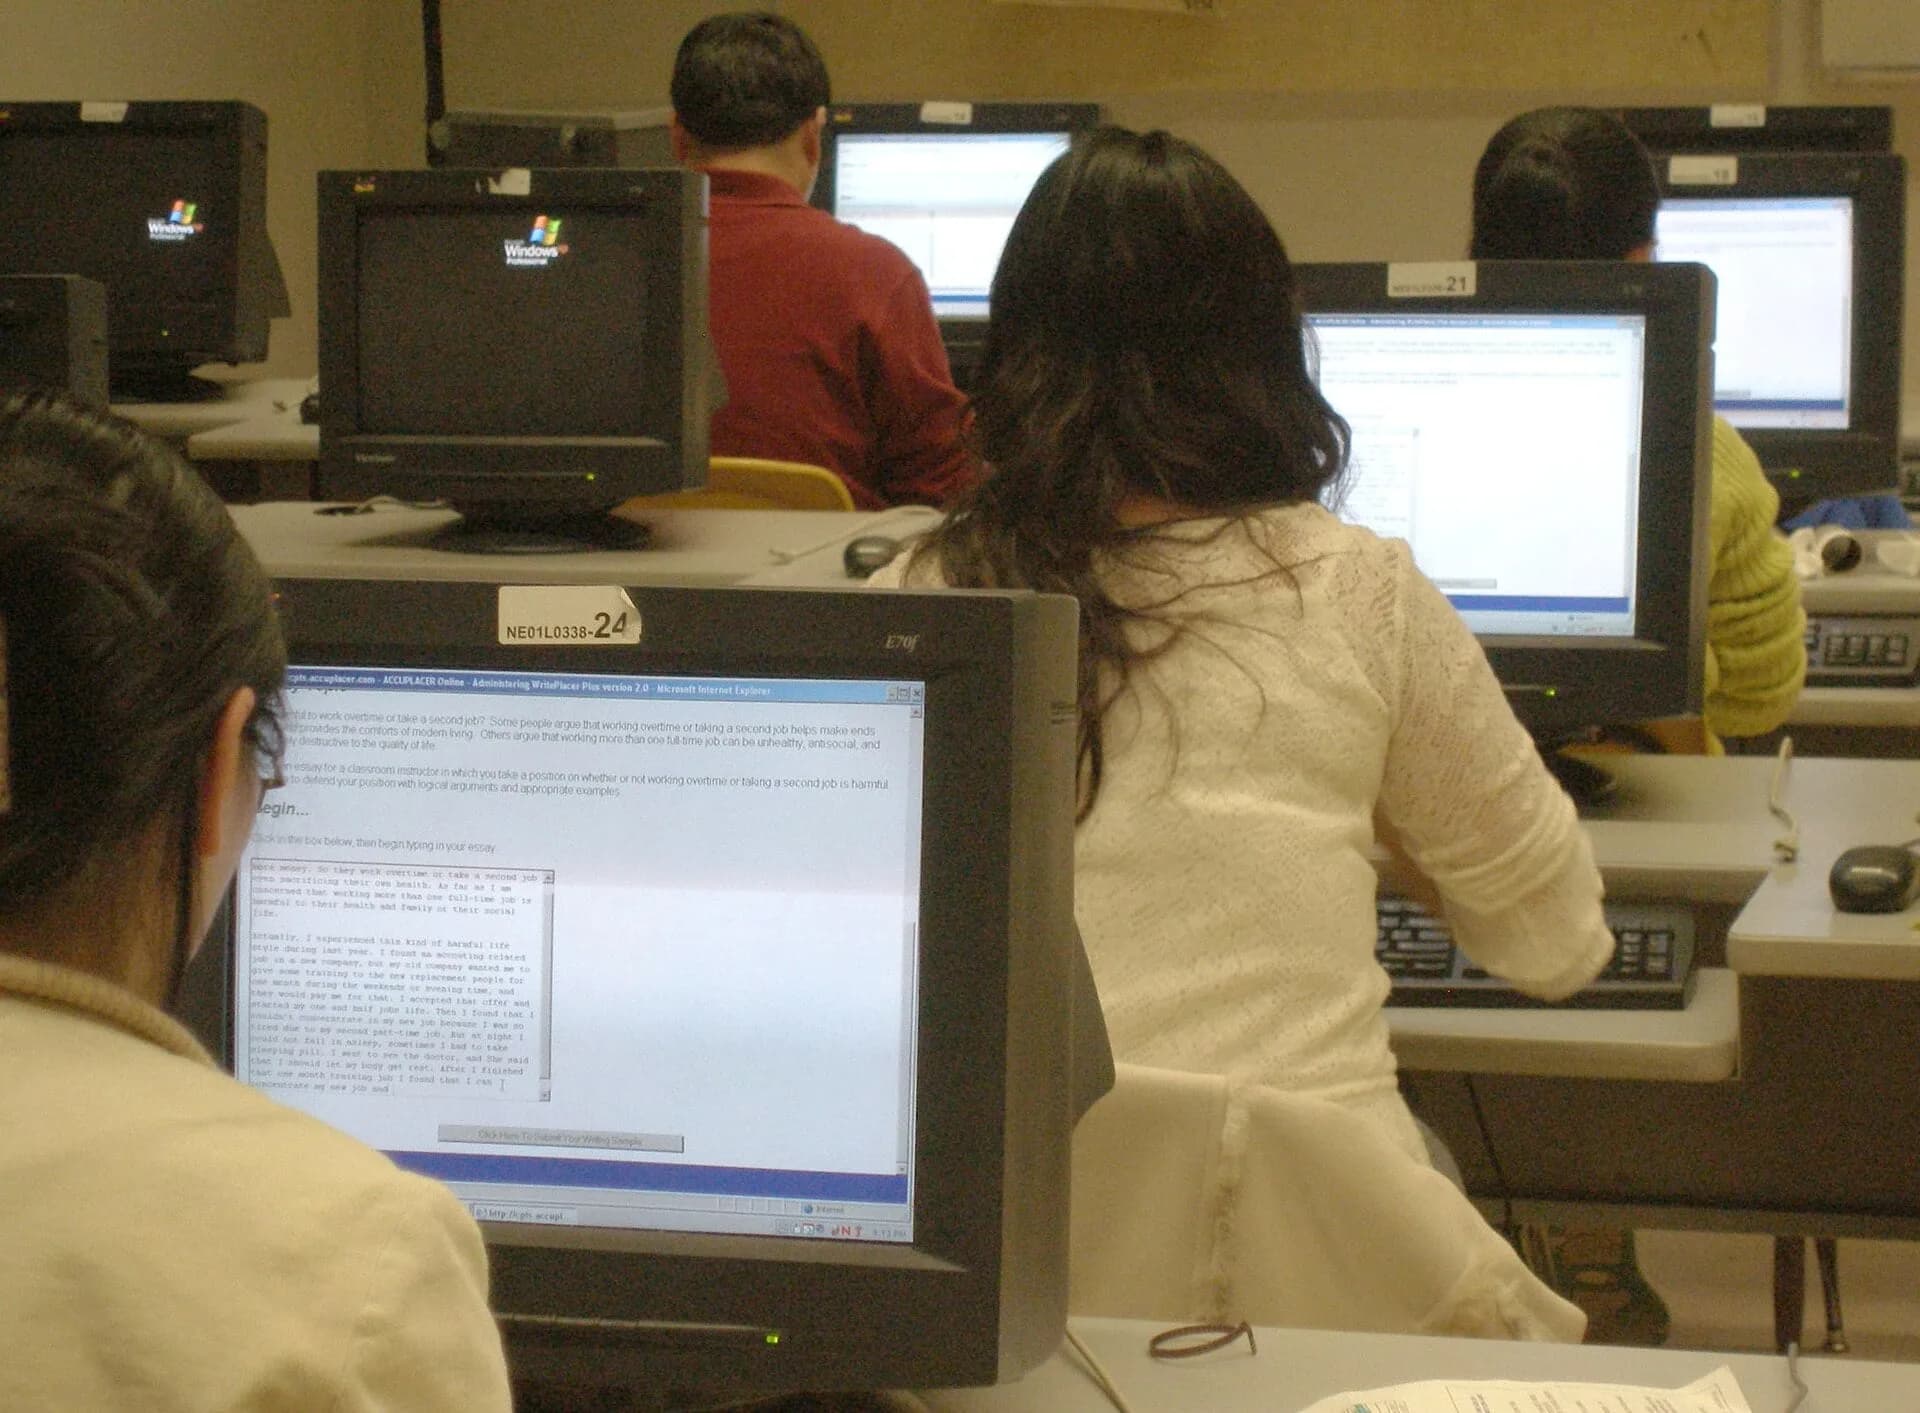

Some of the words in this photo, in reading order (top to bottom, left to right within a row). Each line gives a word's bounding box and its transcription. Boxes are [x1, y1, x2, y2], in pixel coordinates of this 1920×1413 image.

[504, 243, 559, 257] Windows
[506, 612, 628, 639] NE01L0338-24
[382, 676, 436, 685] ACCUPLACER
[436, 678, 464, 686] Online
[471, 679, 530, 690] Administering
[581, 682, 600, 690] Plus
[601, 682, 632, 691] version
[634, 683, 648, 691] 2.0
[656, 684, 695, 692] Microsoft
[697, 685, 732, 693] Internet
[734, 686, 770, 697] Explorer
[307, 710, 317, 719] to
[318, 711, 342, 720] work
[343, 711, 384, 721] overtime
[396, 713, 418, 722] take
[428, 714, 464, 724] second
[464, 715, 485, 727] job?
[489, 716, 518, 725] Some
[519, 717, 552, 729] people
[554, 720, 581, 730] argue
[582, 719, 600, 728] that
[601, 720, 638, 732] working
[640, 721, 680, 730] overtime
[694, 722, 724, 734] taking
[735, 724, 771, 733] second
[771, 725, 788, 736] job
[790, 725, 817, 737] helps
[819, 726, 848, 735] make
[850, 727, 876, 736] ends
[341, 724, 356, 733] the
[358, 725, 398, 735] comforts
[400, 726, 410, 735] of
[411, 727, 447, 736] modern
[479, 729, 511, 739] Others
[512, 732, 539, 742] argue
[541, 731, 559, 740] that
[560, 732, 597, 744] working
[625, 734, 645, 743] than
[704, 736, 721, 748] job
[741, 737, 755, 746] be
[860, 740, 881, 749] and
[350, 738, 360, 746] to
[361, 738, 376, 747] the
[378, 739, 408, 751] quality
[410, 740, 420, 748] of
[290, 774, 301, 782] to
[302, 774, 335, 784] defend
[336, 778, 357, 788] your
[358, 777, 396, 789] position
[397, 778, 416, 787] with
[417, 779, 448, 791] logical
[449, 780, 498, 793] arguments
[500, 783, 518, 791] and
[520, 783, 573, 797] appropriate
[323, 763, 336, 772] for
[346, 764, 395, 774] classroom
[396, 765, 439, 775] instructor
[441, 767, 448, 775] in
[450, 767, 478, 777] which
[478, 770, 497, 780] you
[498, 769, 518, 778] take
[528, 770, 565, 783] position
[580, 772, 617, 782] whether
[630, 774, 644, 782] not
[646, 774, 684, 786] working
[685, 775, 727, 785] overtime
[741, 777, 771, 789] taking
[782, 778, 820, 787] second
[820, 779, 838, 790] job
[839, 779, 849, 788] is
[851, 780, 888, 789] harmful
